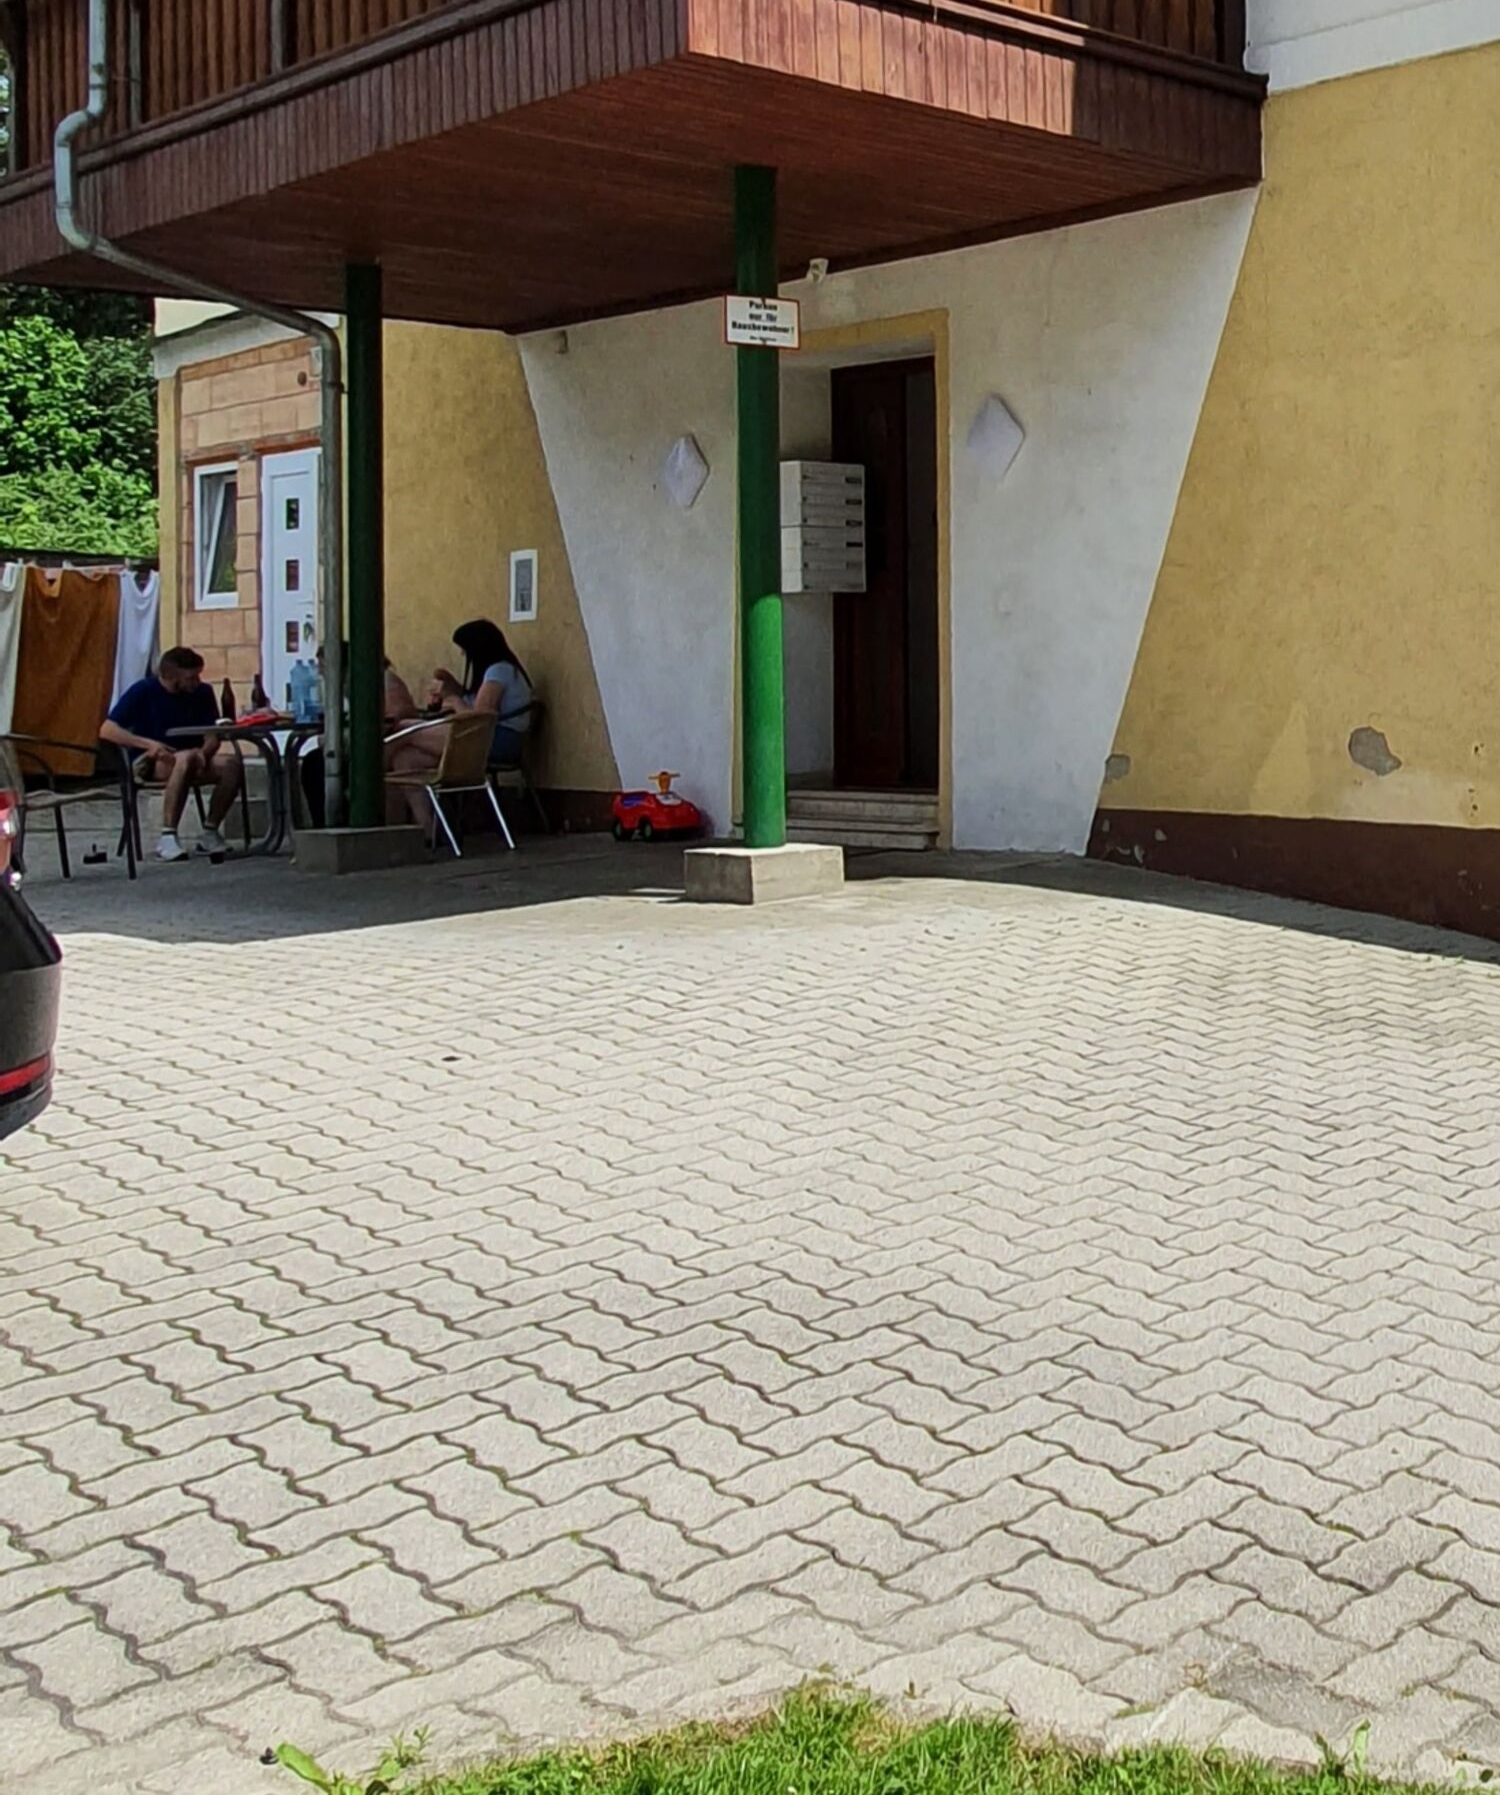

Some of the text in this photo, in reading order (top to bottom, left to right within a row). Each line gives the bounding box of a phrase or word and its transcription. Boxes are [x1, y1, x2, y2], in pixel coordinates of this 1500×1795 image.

[749, 300, 778, 311] Parken
[749, 312, 778, 322] nur für
